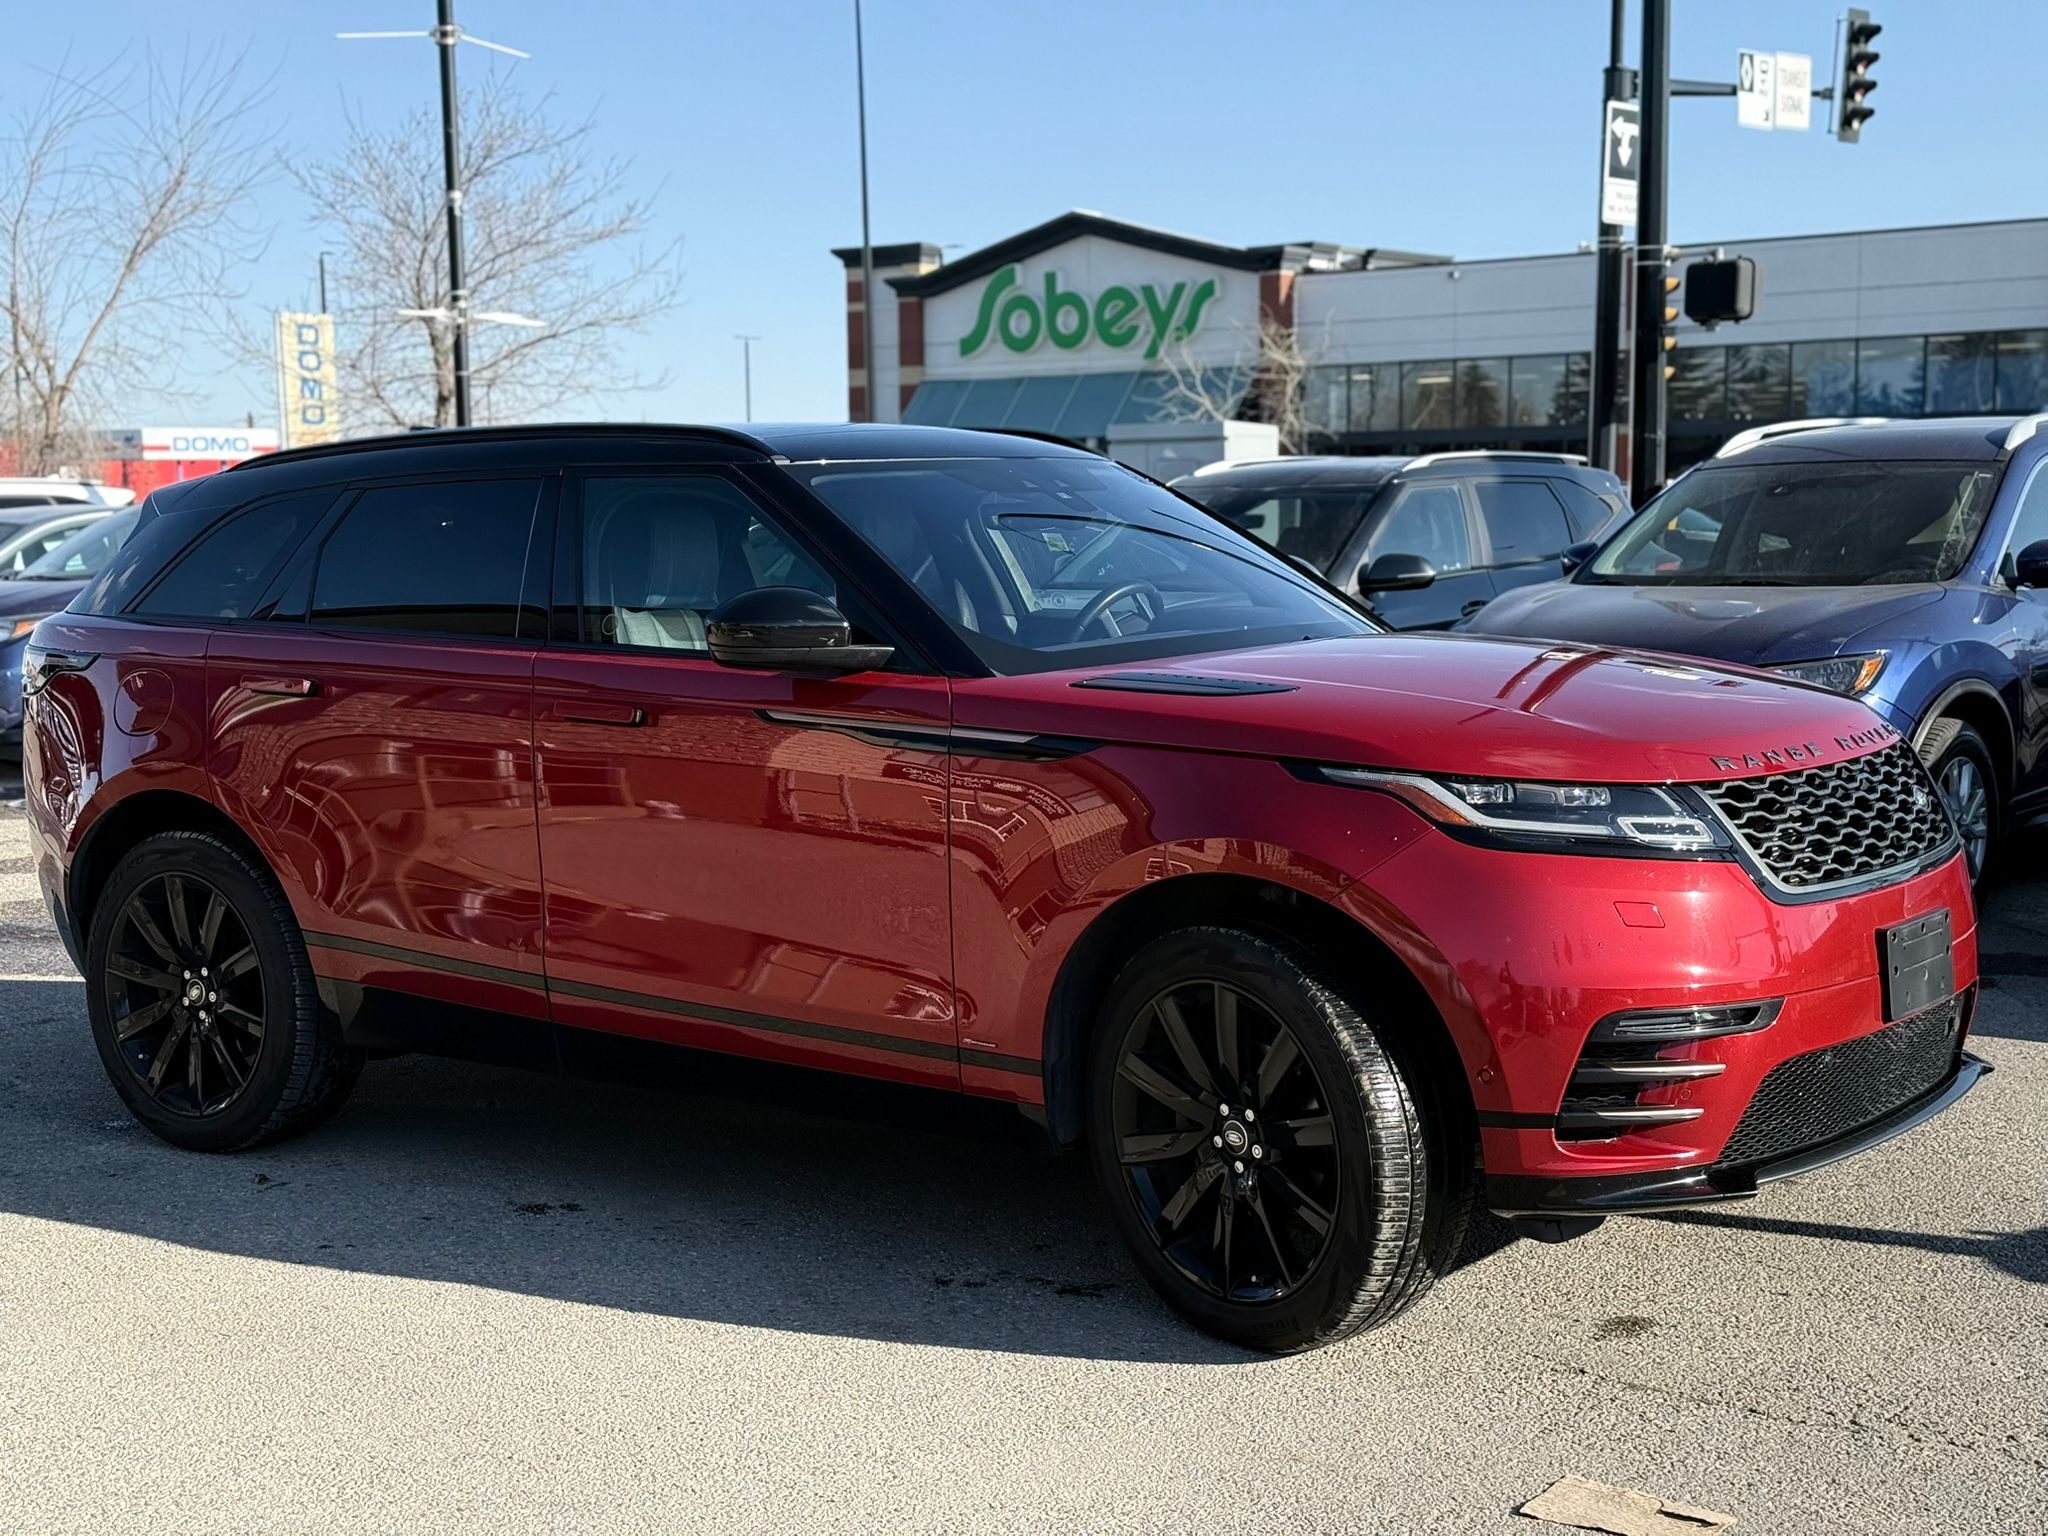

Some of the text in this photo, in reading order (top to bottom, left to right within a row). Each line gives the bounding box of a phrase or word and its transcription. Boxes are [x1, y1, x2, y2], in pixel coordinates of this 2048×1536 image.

[960, 263, 1216, 358] Sobeys
[296, 324, 325, 425] DOMO
[173, 437, 249, 452] DOMO
[1709, 723, 1901, 771] RANGE ROVER
